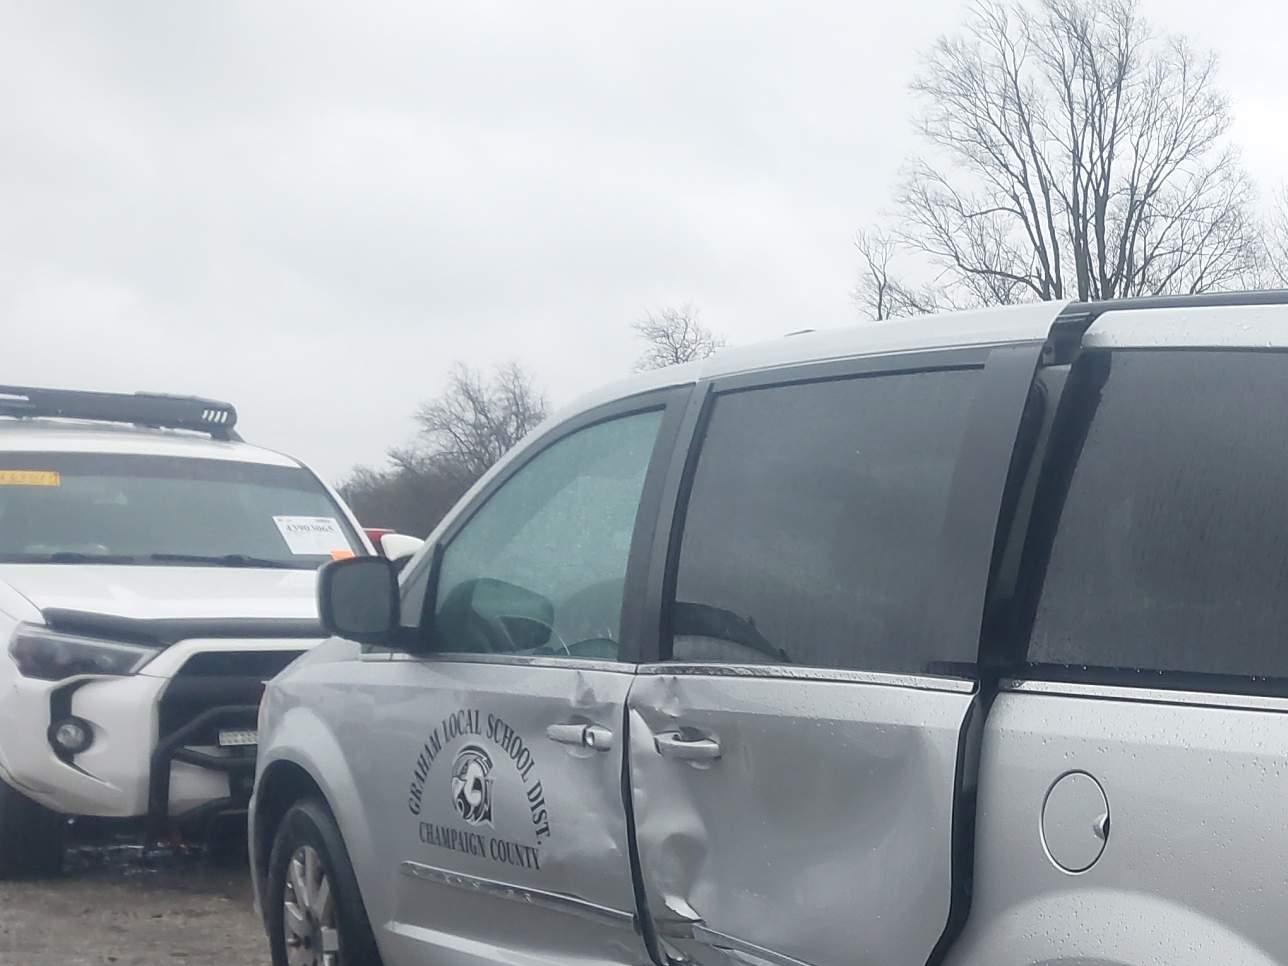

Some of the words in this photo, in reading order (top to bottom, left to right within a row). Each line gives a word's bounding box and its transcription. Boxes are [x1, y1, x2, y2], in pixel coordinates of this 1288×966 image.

[408, 729, 442, 816] GRAHAM
[442, 709, 482, 743] LOCAL
[486, 713, 535, 783] SCHOOL
[526, 781, 551, 846] DIST.
[418, 821, 487, 858] CHAMPAIGN
[489, 837, 541, 871] COUNTY
